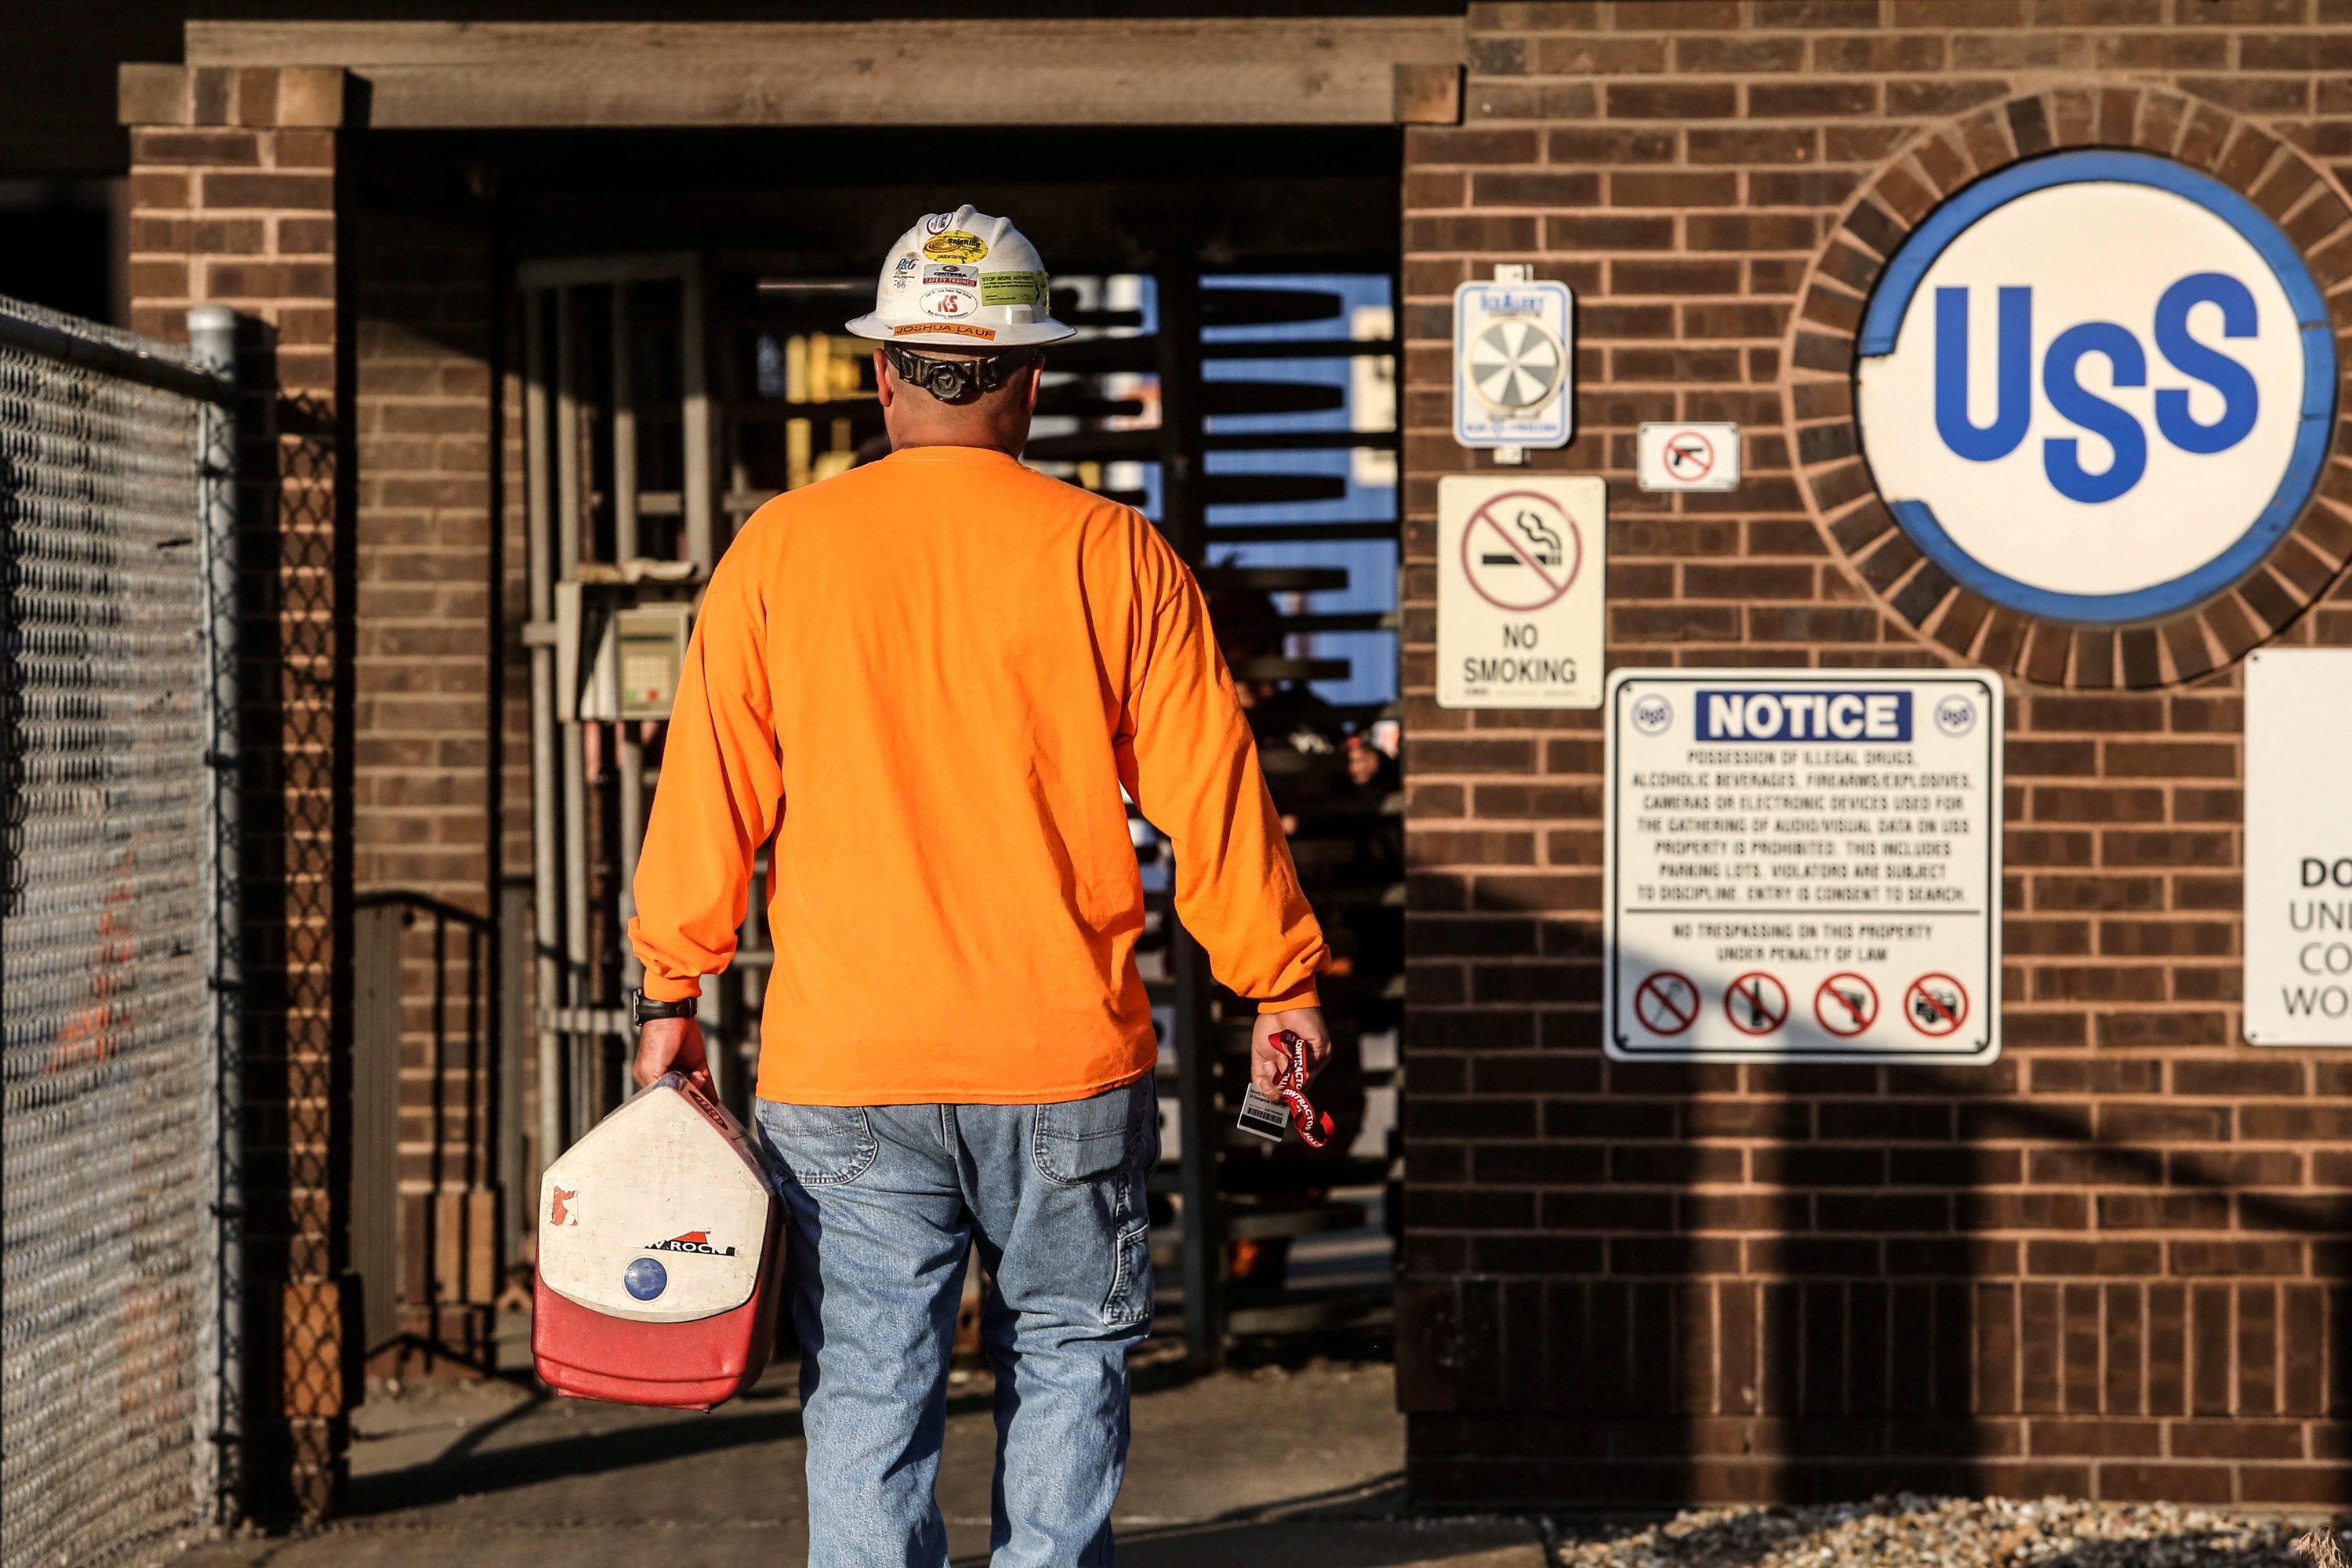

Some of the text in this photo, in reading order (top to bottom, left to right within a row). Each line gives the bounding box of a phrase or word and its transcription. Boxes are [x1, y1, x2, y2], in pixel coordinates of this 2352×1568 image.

[895, 258, 919, 270] P&G
[896, 325, 994, 337] JOSHUA LAUF
[1935, 271, 2259, 504] USS
[1503, 623, 1538, 649] NO
[1463, 656, 1577, 684] SMOKING
[1708, 692, 1900, 739] NOTICE
[1688, 750, 1776, 766] POSSESSION
[1780, 750, 1797, 765] OF
[1802, 750, 1857, 766] ILLEGAL
[1632, 772, 1709, 788] ALCOHOLIC
[1643, 794, 1963, 811] CAMERAS OR ELECTRONIC DEVICES USED FOR
[1638, 817, 1661, 833] THE
[1668, 818, 1747, 833] GATHERING
[1751, 818, 1768, 833] OF
[1878, 818, 1913, 834] DATA
[1917, 818, 1936, 834] ON
[1942, 818, 1969, 834] USS
[1655, 840, 1727, 855] PROPERTY
[1733, 840, 1746, 856] IS
[1846, 840, 1877, 856] THIS
[1882, 841, 1951, 857] INCLUDES
[1660, 862, 1721, 879] PARKING
[1771, 863, 1849, 879] VIOLATORS
[1854, 863, 1879, 879] ARE
[1886, 864, 1945, 880] SUBJECT
[1638, 885, 1655, 902] TO
[1747, 885, 1791, 901] ENTRY
[1797, 886, 1810, 902] IS
[1815, 886, 1878, 902] CONSENT
[1886, 887, 1903, 902] TO
[2289, 902, 2352, 932] UN
[1673, 923, 1933, 940] NO TRESPASSING ON THIS PROPERTY
[1717, 946, 1888, 962] UNDER PENALTY OF LAW
[2281, 985, 2352, 1019] WO
[1294, 1039, 1305, 1091] CONTRACTO
